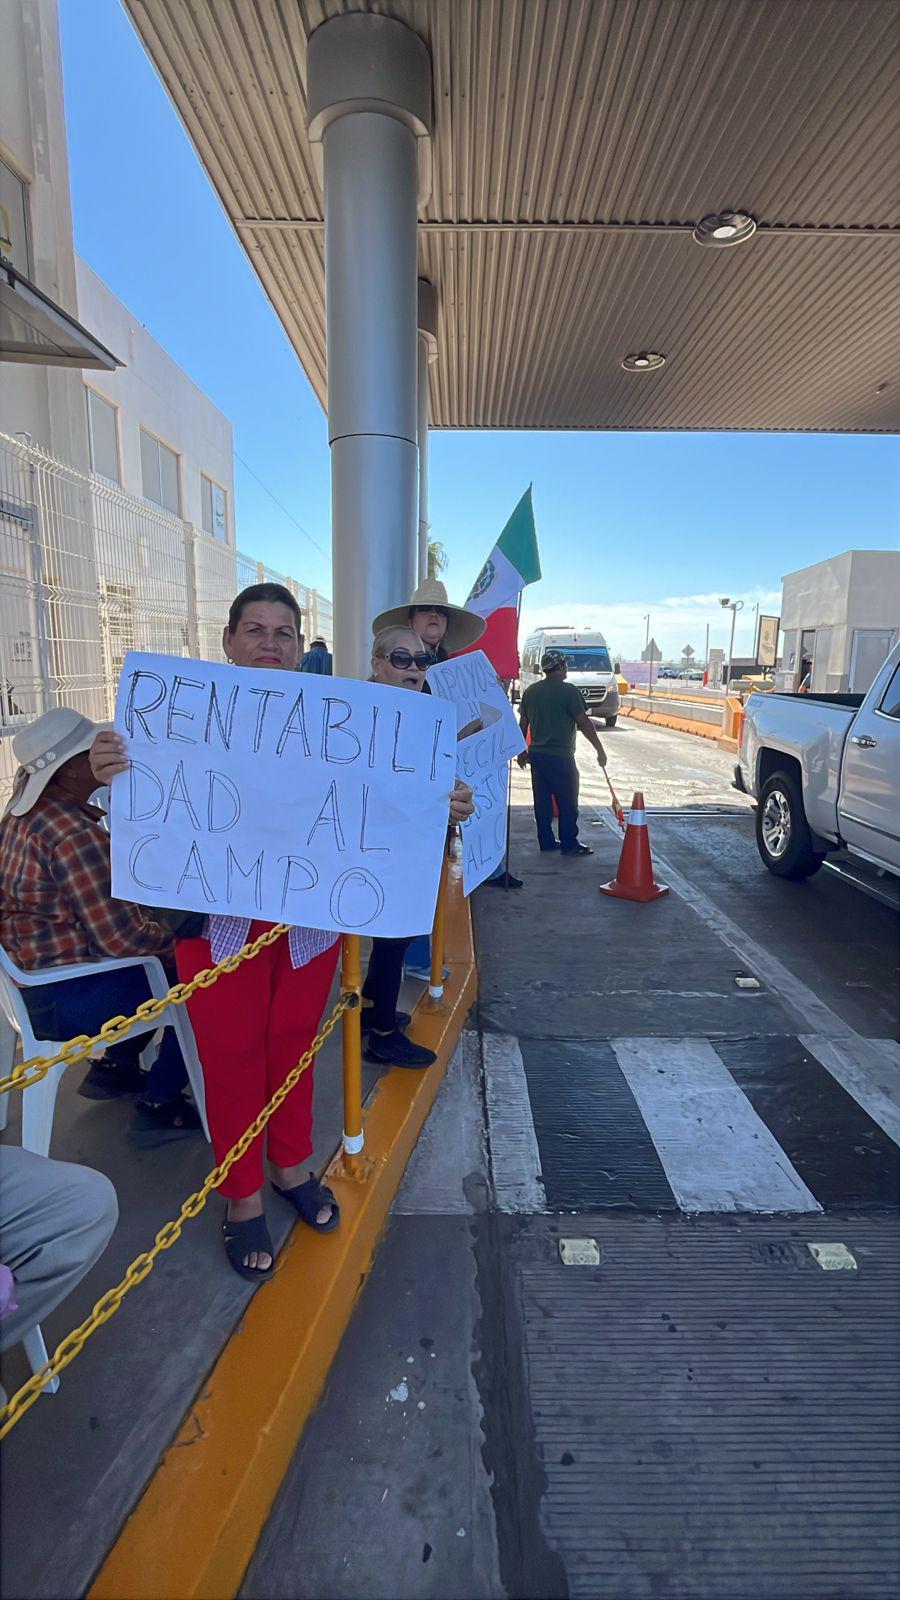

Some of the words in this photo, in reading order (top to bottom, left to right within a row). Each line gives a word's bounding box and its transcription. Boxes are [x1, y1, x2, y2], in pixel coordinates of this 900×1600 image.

[123, 759, 242, 833] DAD
[306, 779, 391, 853] AL
[128, 833, 385, 928] CAMPO
